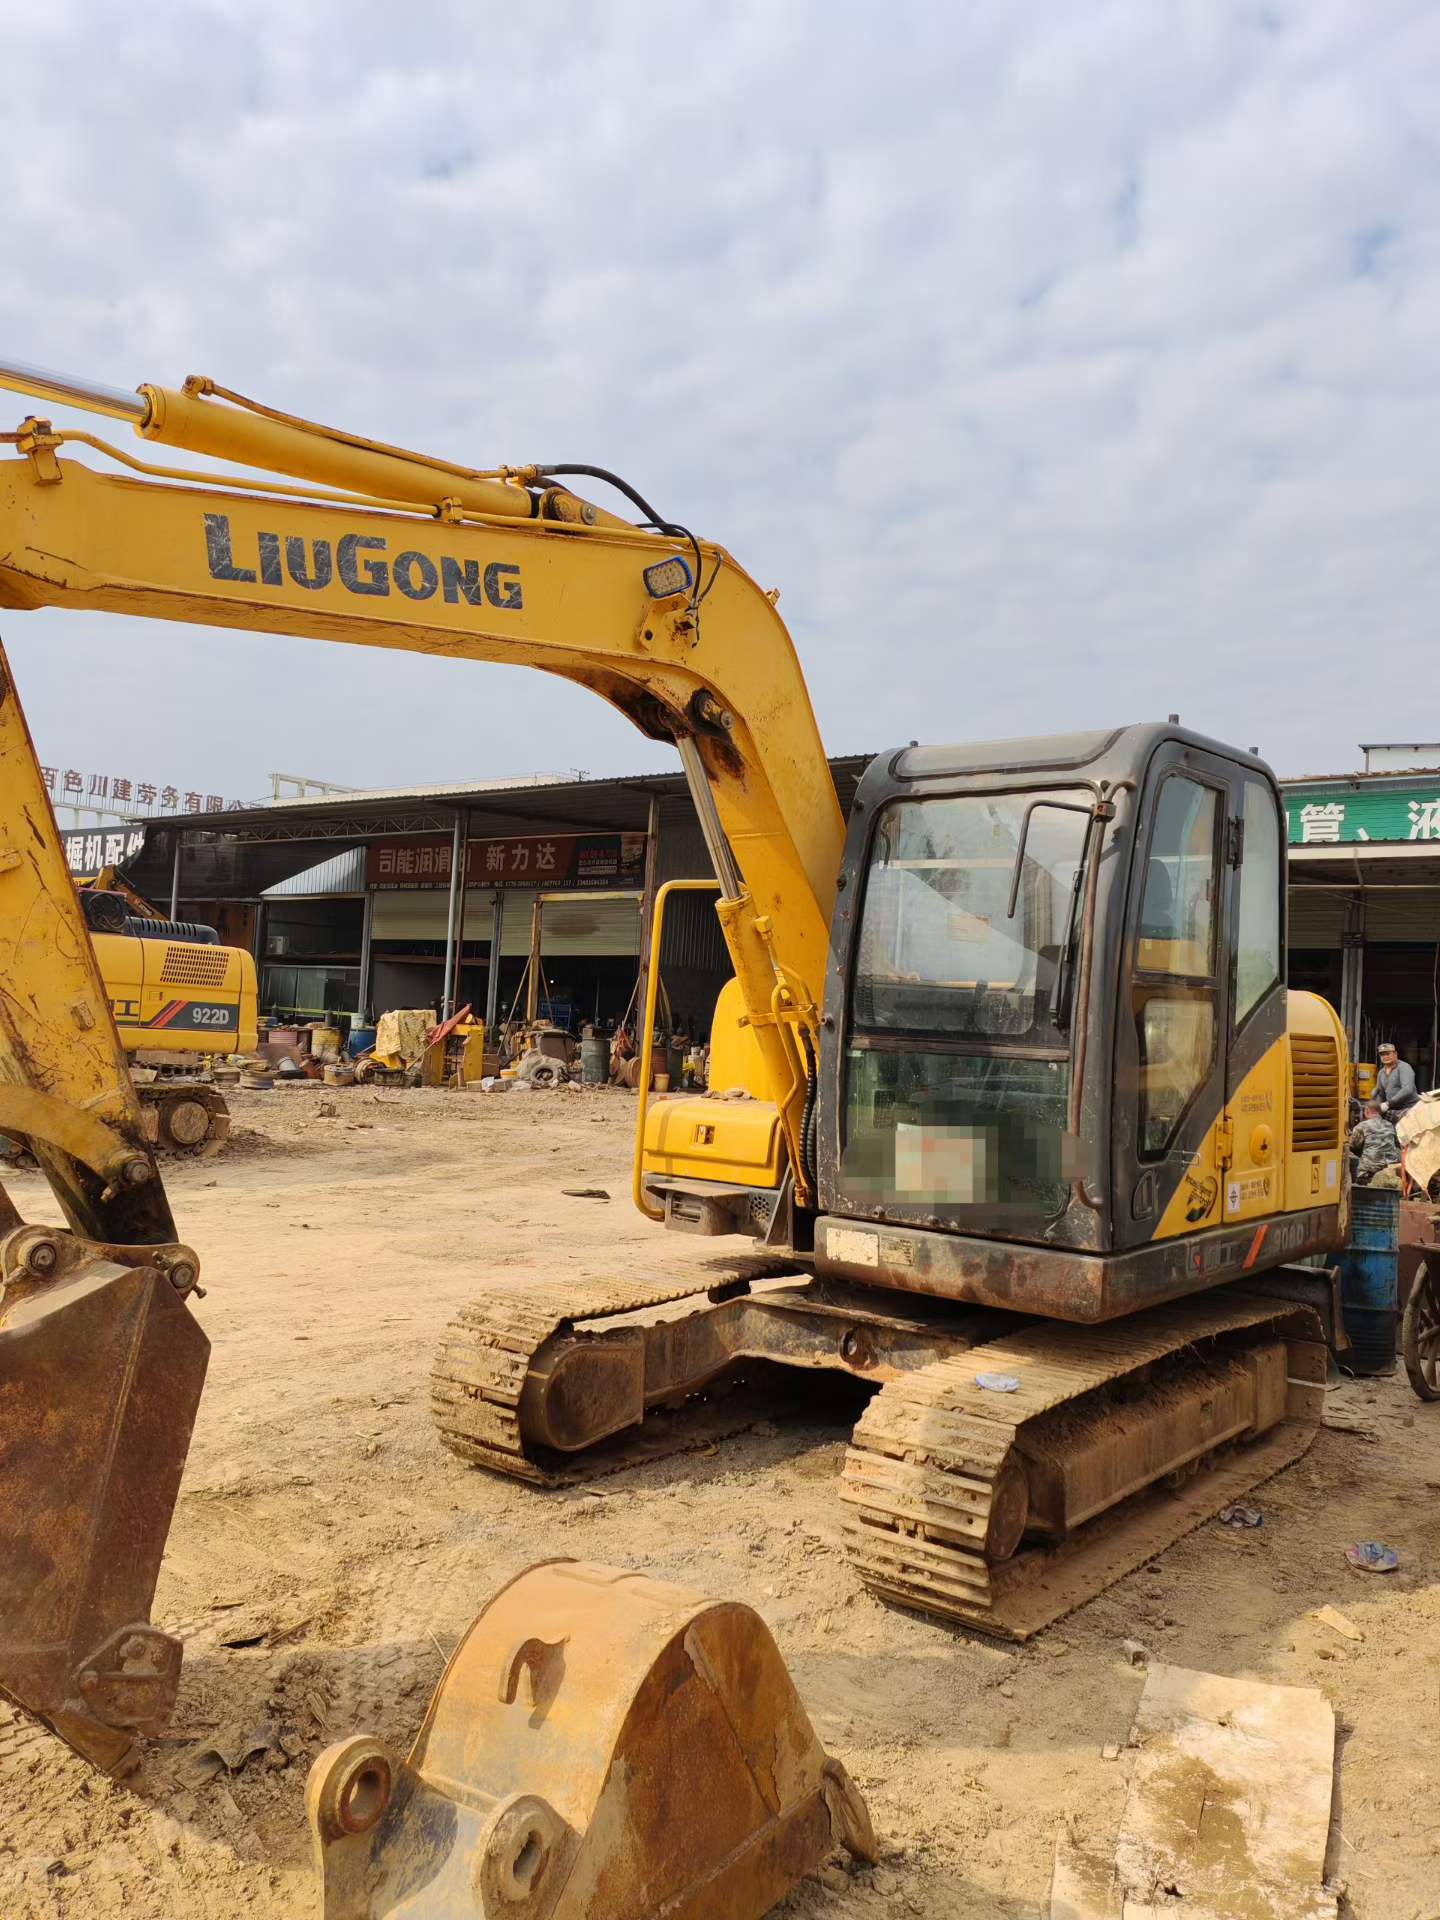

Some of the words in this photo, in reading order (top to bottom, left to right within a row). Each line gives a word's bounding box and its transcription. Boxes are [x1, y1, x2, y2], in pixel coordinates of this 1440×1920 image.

[486, 842, 557, 873] 新力达
[108, 999, 139, 1017] 工
[193, 1007, 230, 1025] 922D
